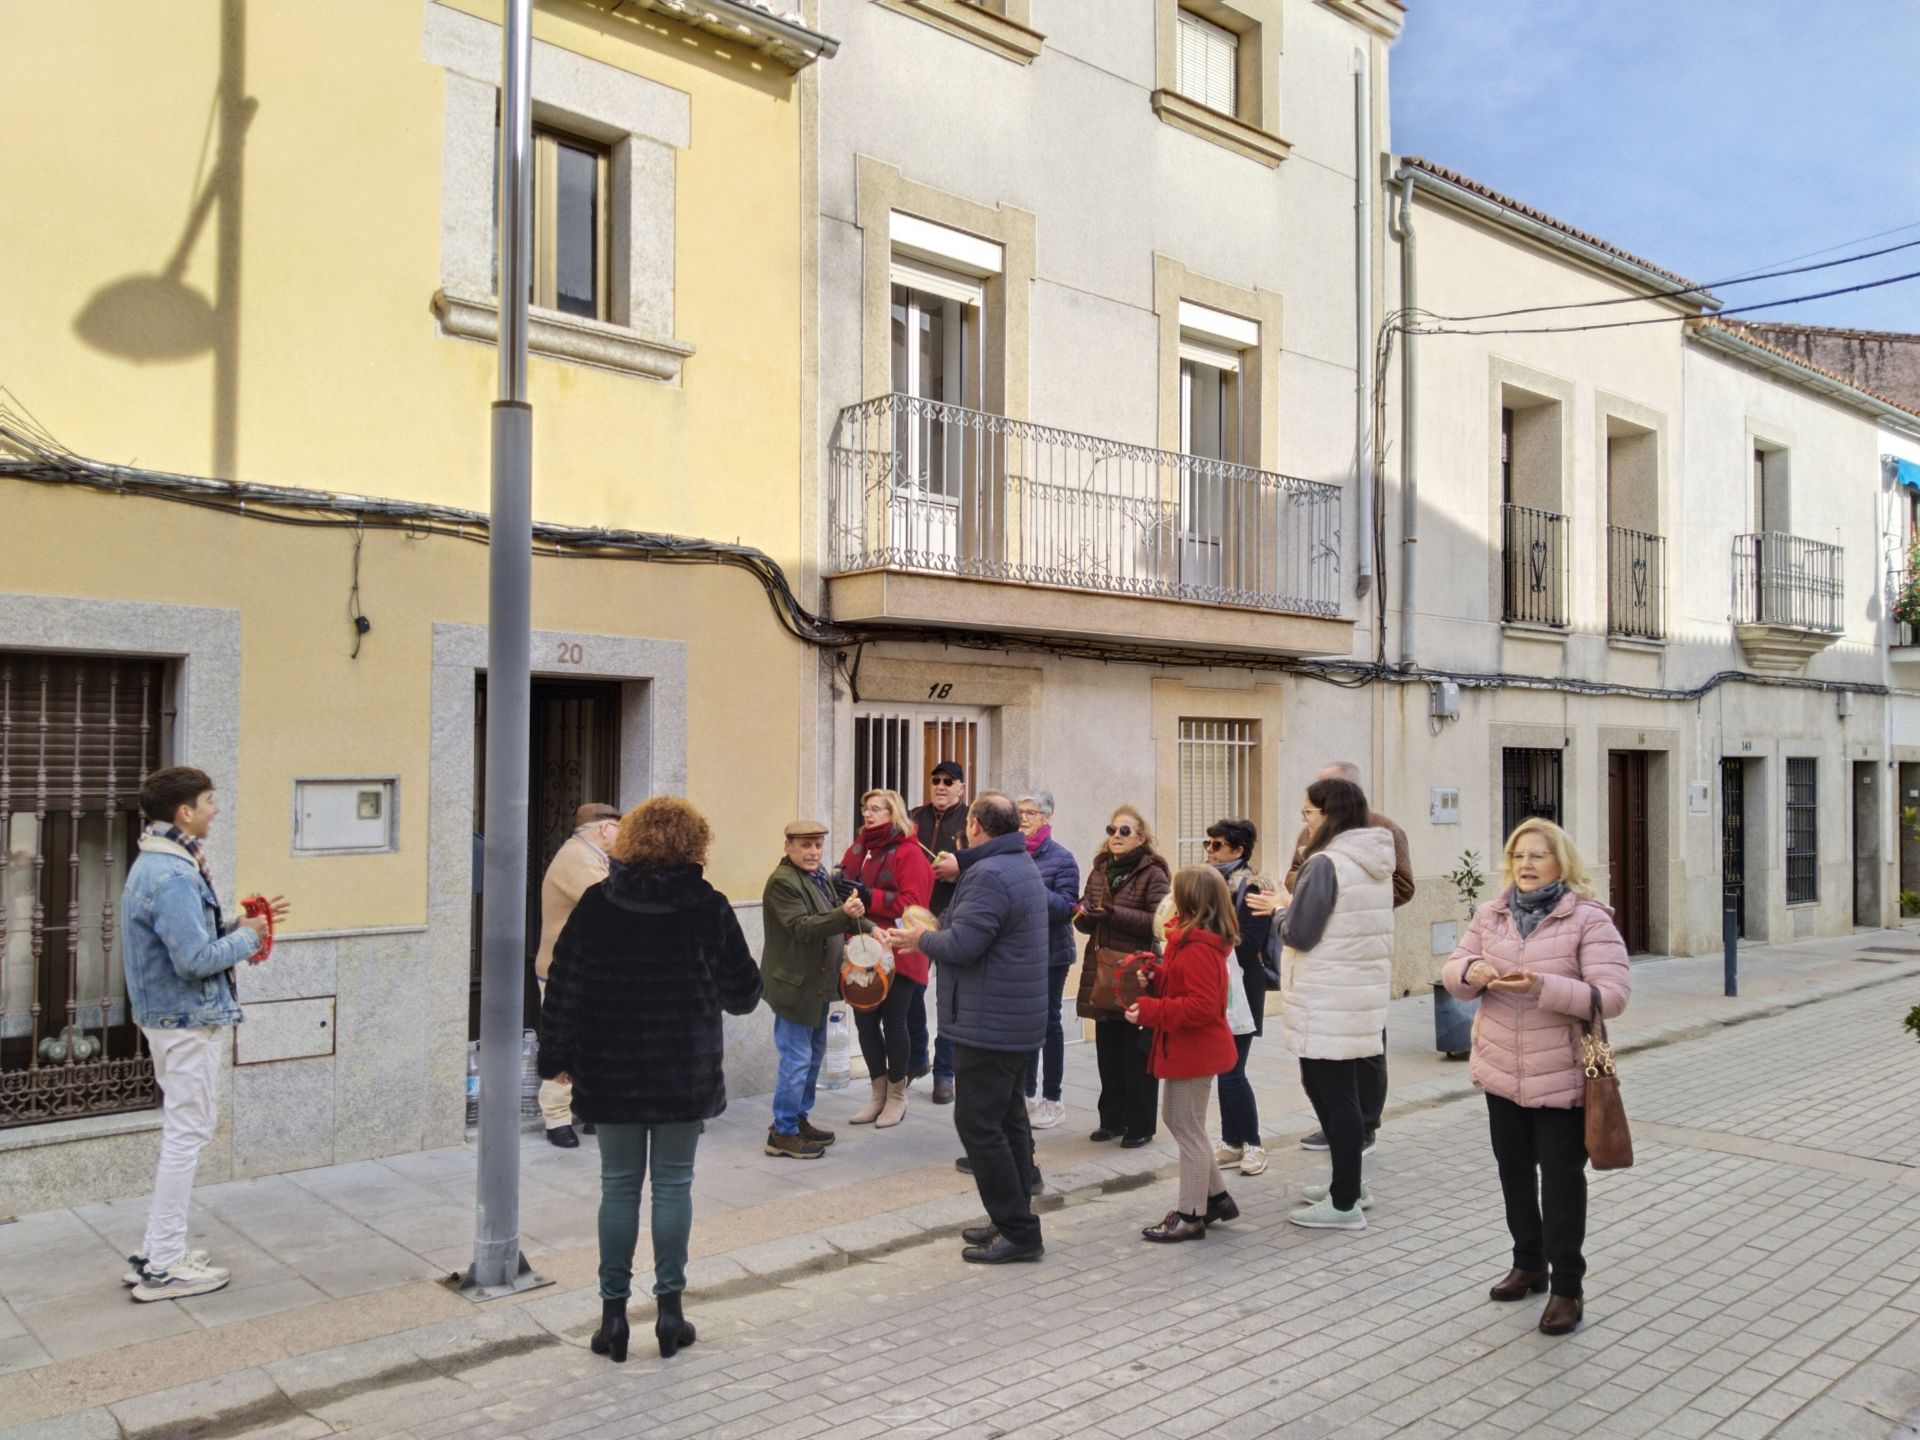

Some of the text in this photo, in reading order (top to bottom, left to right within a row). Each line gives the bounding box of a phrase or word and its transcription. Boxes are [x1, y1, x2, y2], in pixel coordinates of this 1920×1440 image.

[557, 642, 583, 664] 20
[928, 683, 953, 699] 18
[1638, 733, 1646, 744] 16
